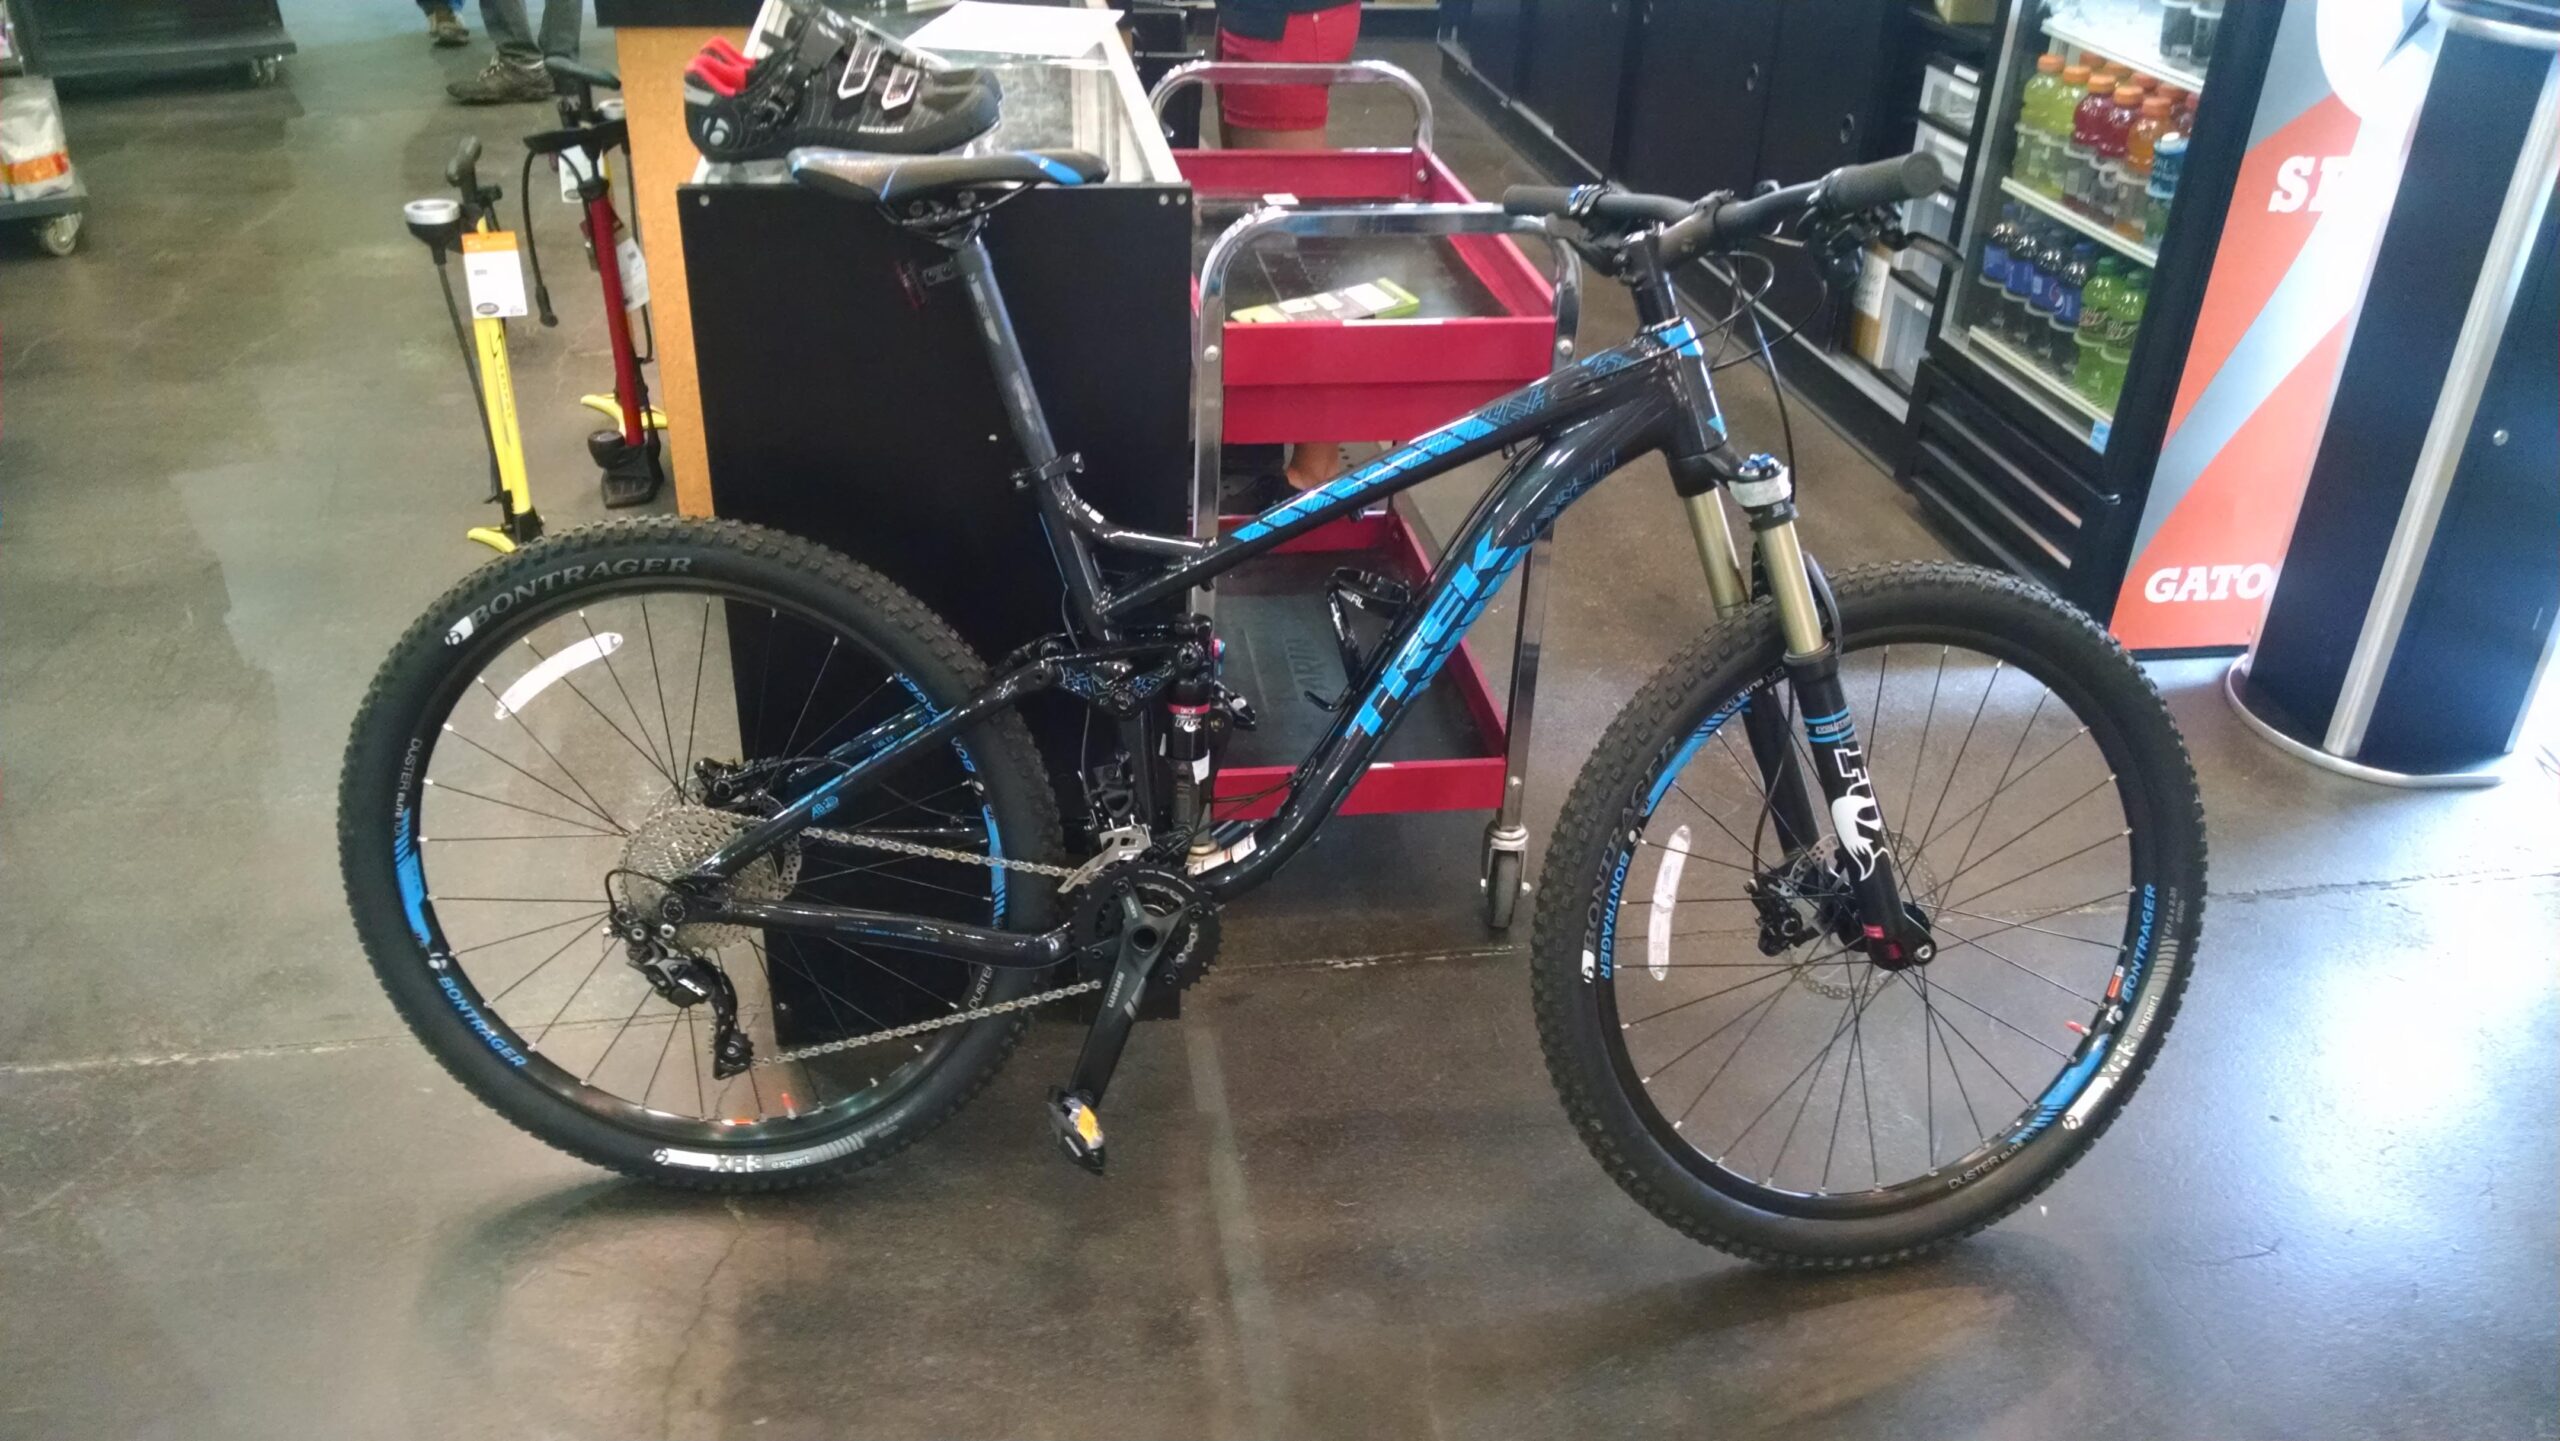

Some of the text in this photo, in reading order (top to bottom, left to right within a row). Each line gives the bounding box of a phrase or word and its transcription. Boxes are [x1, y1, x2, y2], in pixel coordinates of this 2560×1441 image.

[469, 557, 692, 630] BONTRAGER
[1344, 526, 1508, 738] TREK
[399, 738, 422, 791] DUSTER
[1583, 736, 1676, 951] BONTRAGER
[1600, 849, 1630, 979] BONTRAGER
[2121, 884, 2156, 1003] BONTRAGER
[437, 976, 528, 1067] BONTRAGER
[2137, 995, 2161, 1034] expert
[770, 1155, 811, 1170] expert
[1948, 1155, 2000, 1189] DUSTER
